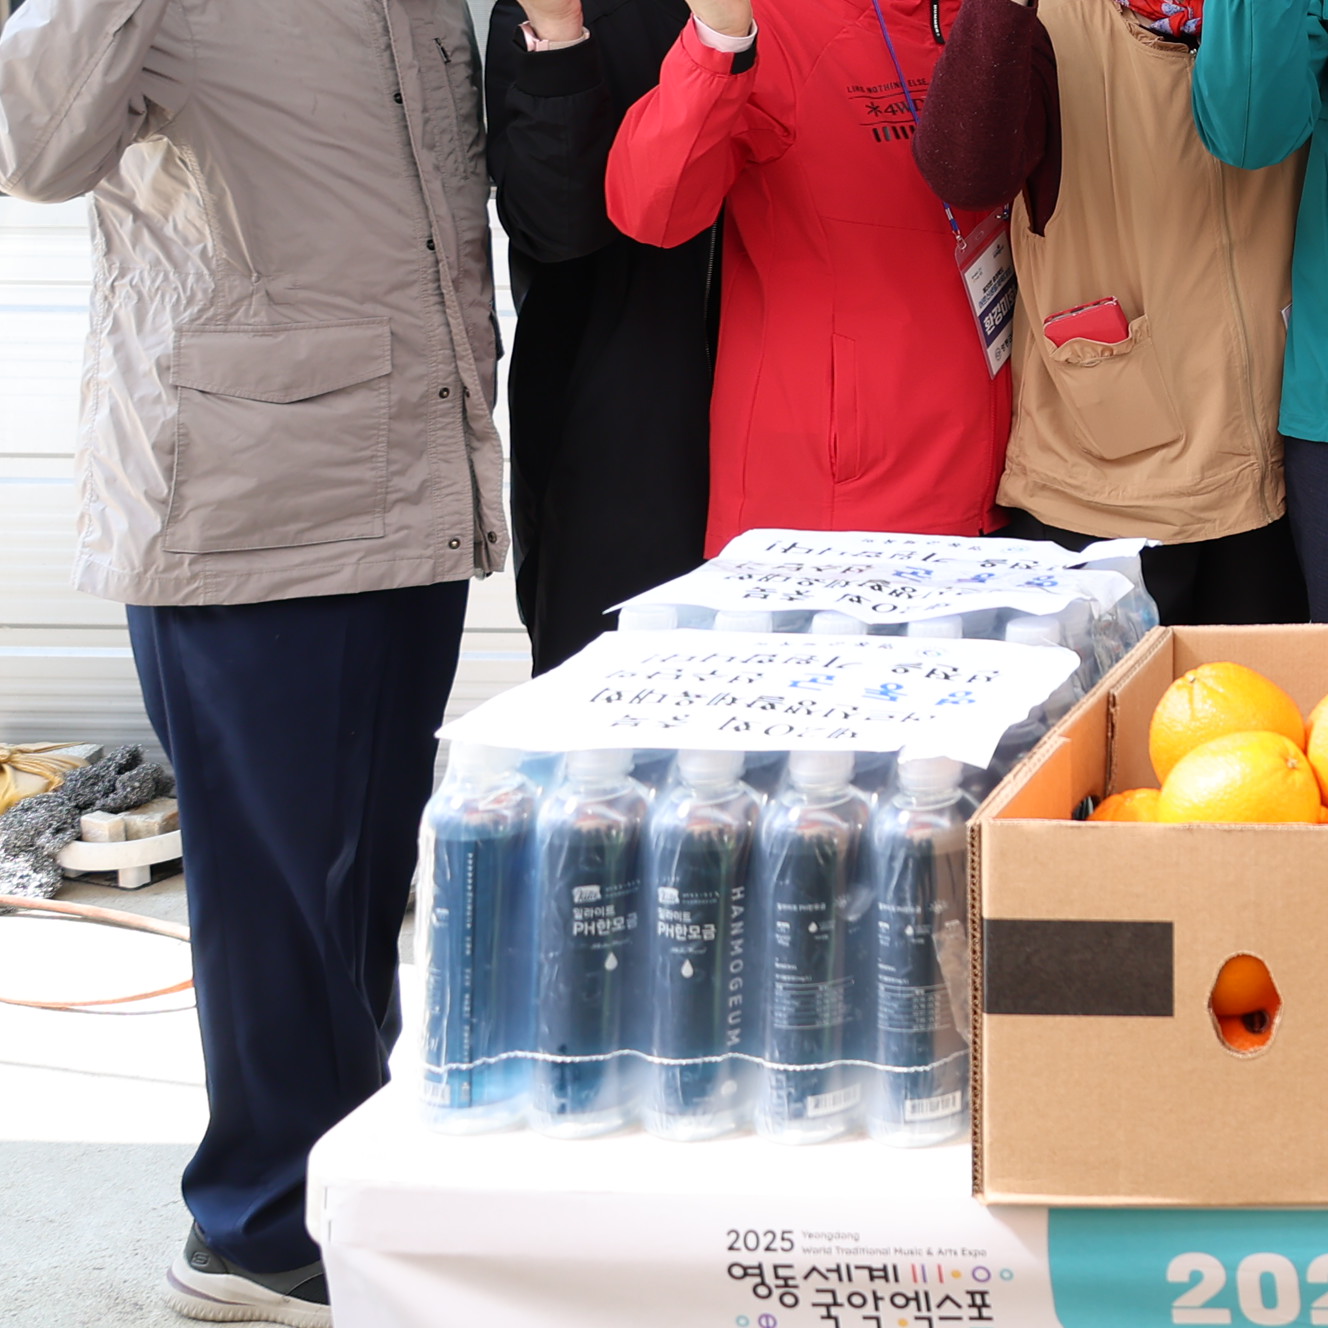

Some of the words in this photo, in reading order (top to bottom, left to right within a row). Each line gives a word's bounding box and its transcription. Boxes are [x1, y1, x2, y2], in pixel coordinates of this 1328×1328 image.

[572, 912, 638, 937] PH한모금
[657, 921, 716, 941] PH한모금
[726, 886, 745, 1047] HANMOGEUM
[726, 1229, 795, 1252] 2025
[802, 1230, 860, 1241] Yeongdong
[802, 1245, 832, 1256] World
[836, 1246, 891, 1256] Traditional
[894, 1247, 923, 1257] Music
[937, 1248, 958, 1257] Arts
[961, 1248, 987, 1259] Expo
[727, 1261, 900, 1308] 영동세계
[811, 1288, 994, 1328] 국악엑스포
